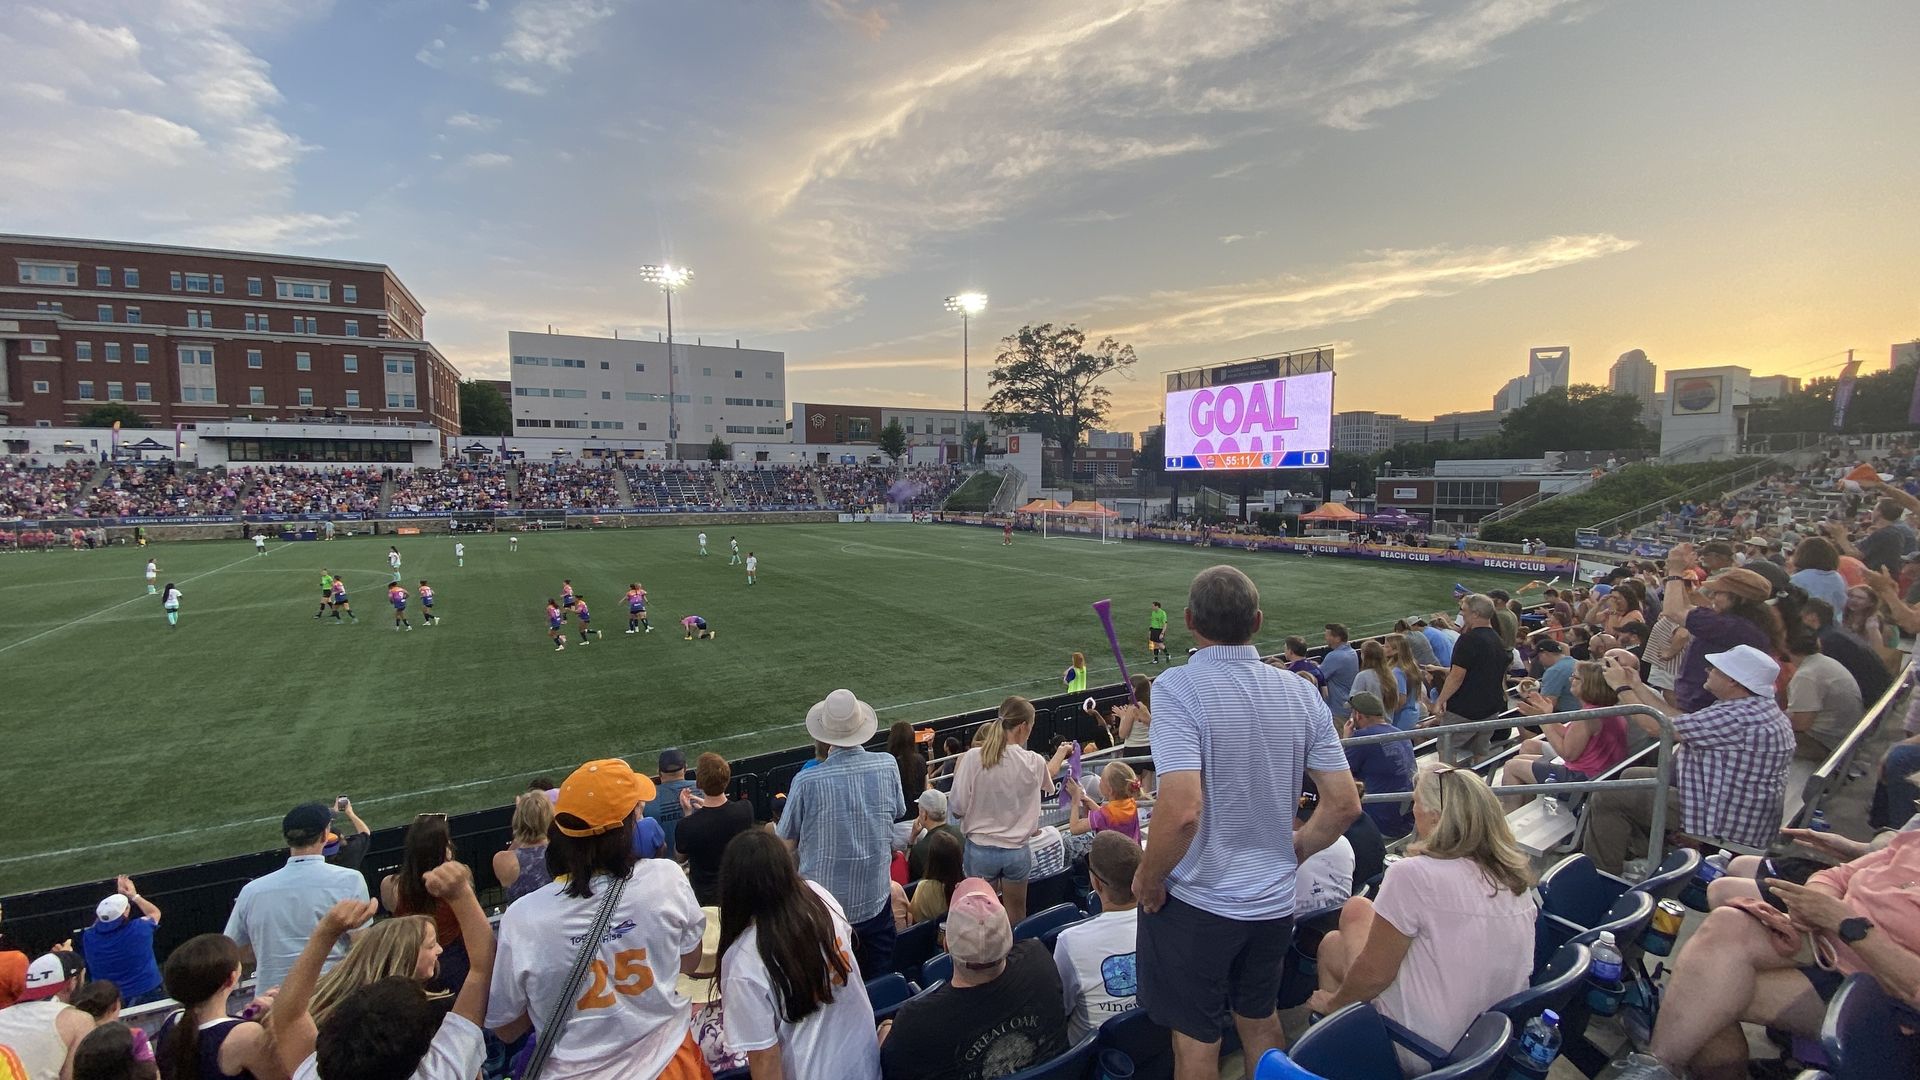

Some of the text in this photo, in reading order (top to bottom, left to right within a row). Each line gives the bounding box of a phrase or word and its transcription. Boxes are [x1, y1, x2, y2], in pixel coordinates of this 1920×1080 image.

[1189, 380, 1298, 437] GOAL
[1225, 456, 1250, 466] 55:11
[1311, 454, 1318, 463] 0
[1294, 544, 1338, 553] BEAH CLUB
[1380, 551, 1430, 561] BEACH CLUB
[1484, 559, 1546, 571] BEACH CLUB
[577, 948, 652, 1010] 25
[965, 1015, 1040, 1060] GREAT OAK
